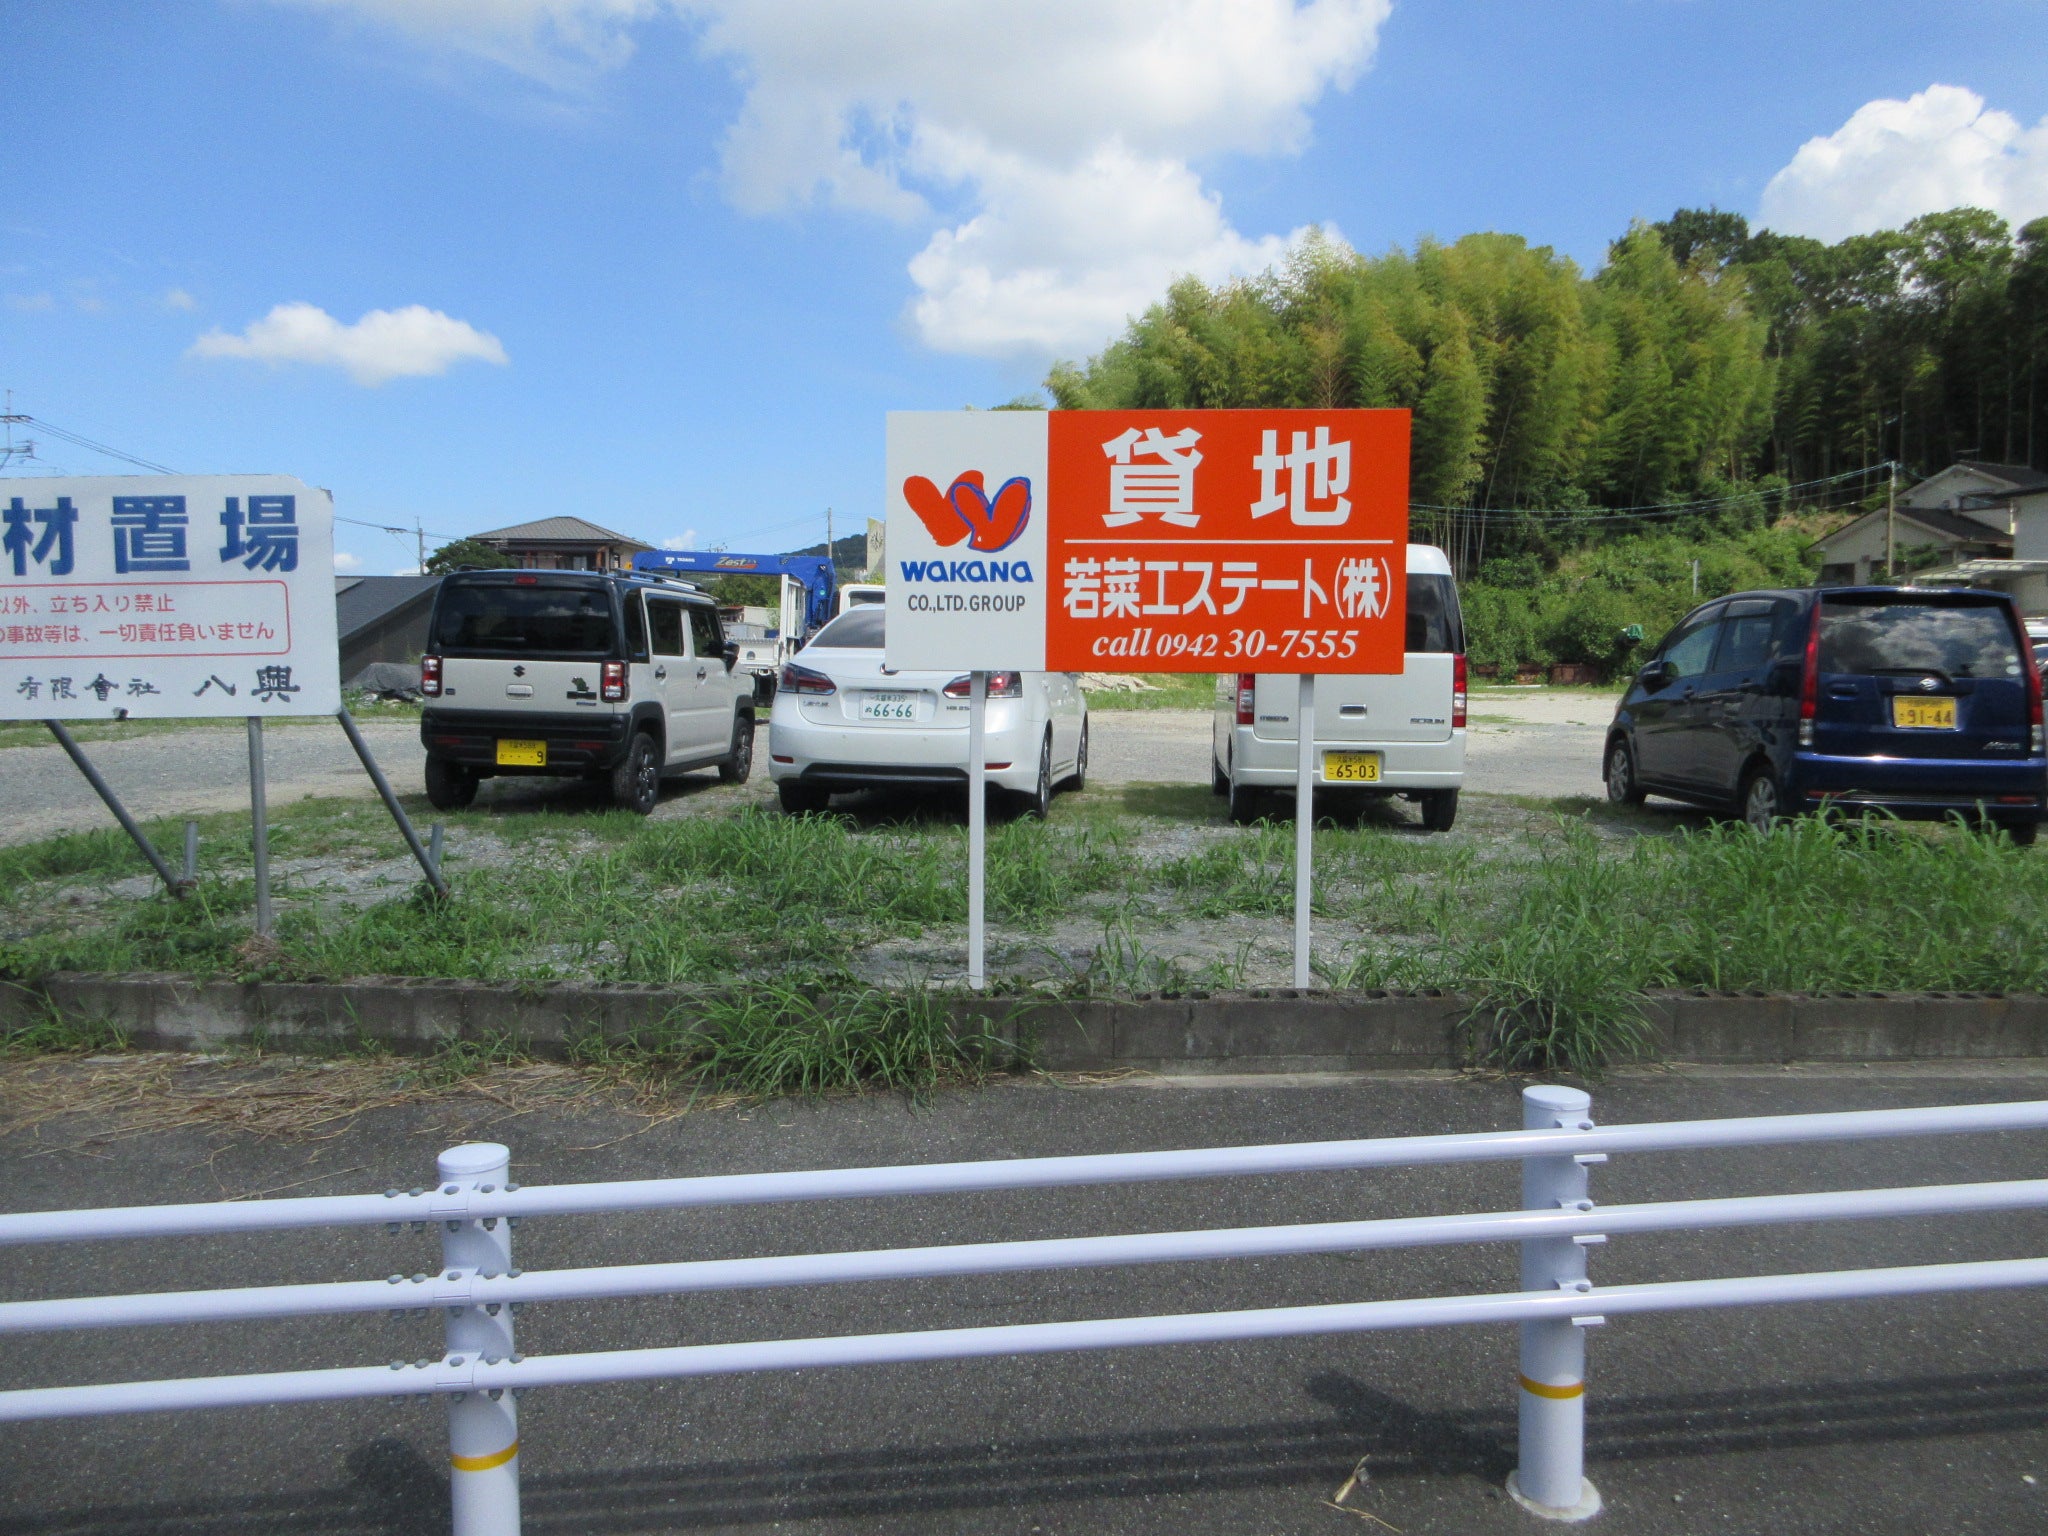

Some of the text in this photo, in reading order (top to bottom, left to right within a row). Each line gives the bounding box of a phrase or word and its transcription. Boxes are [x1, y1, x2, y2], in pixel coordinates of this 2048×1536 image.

[1101, 427, 1352, 528] 貸地
[2, 494, 299, 576] 材置場
[1092, 628, 1359, 658] call 0942 30-7555
[874, 703, 912, 718] 66-66
[1336, 764, 1376, 778] 65-03
